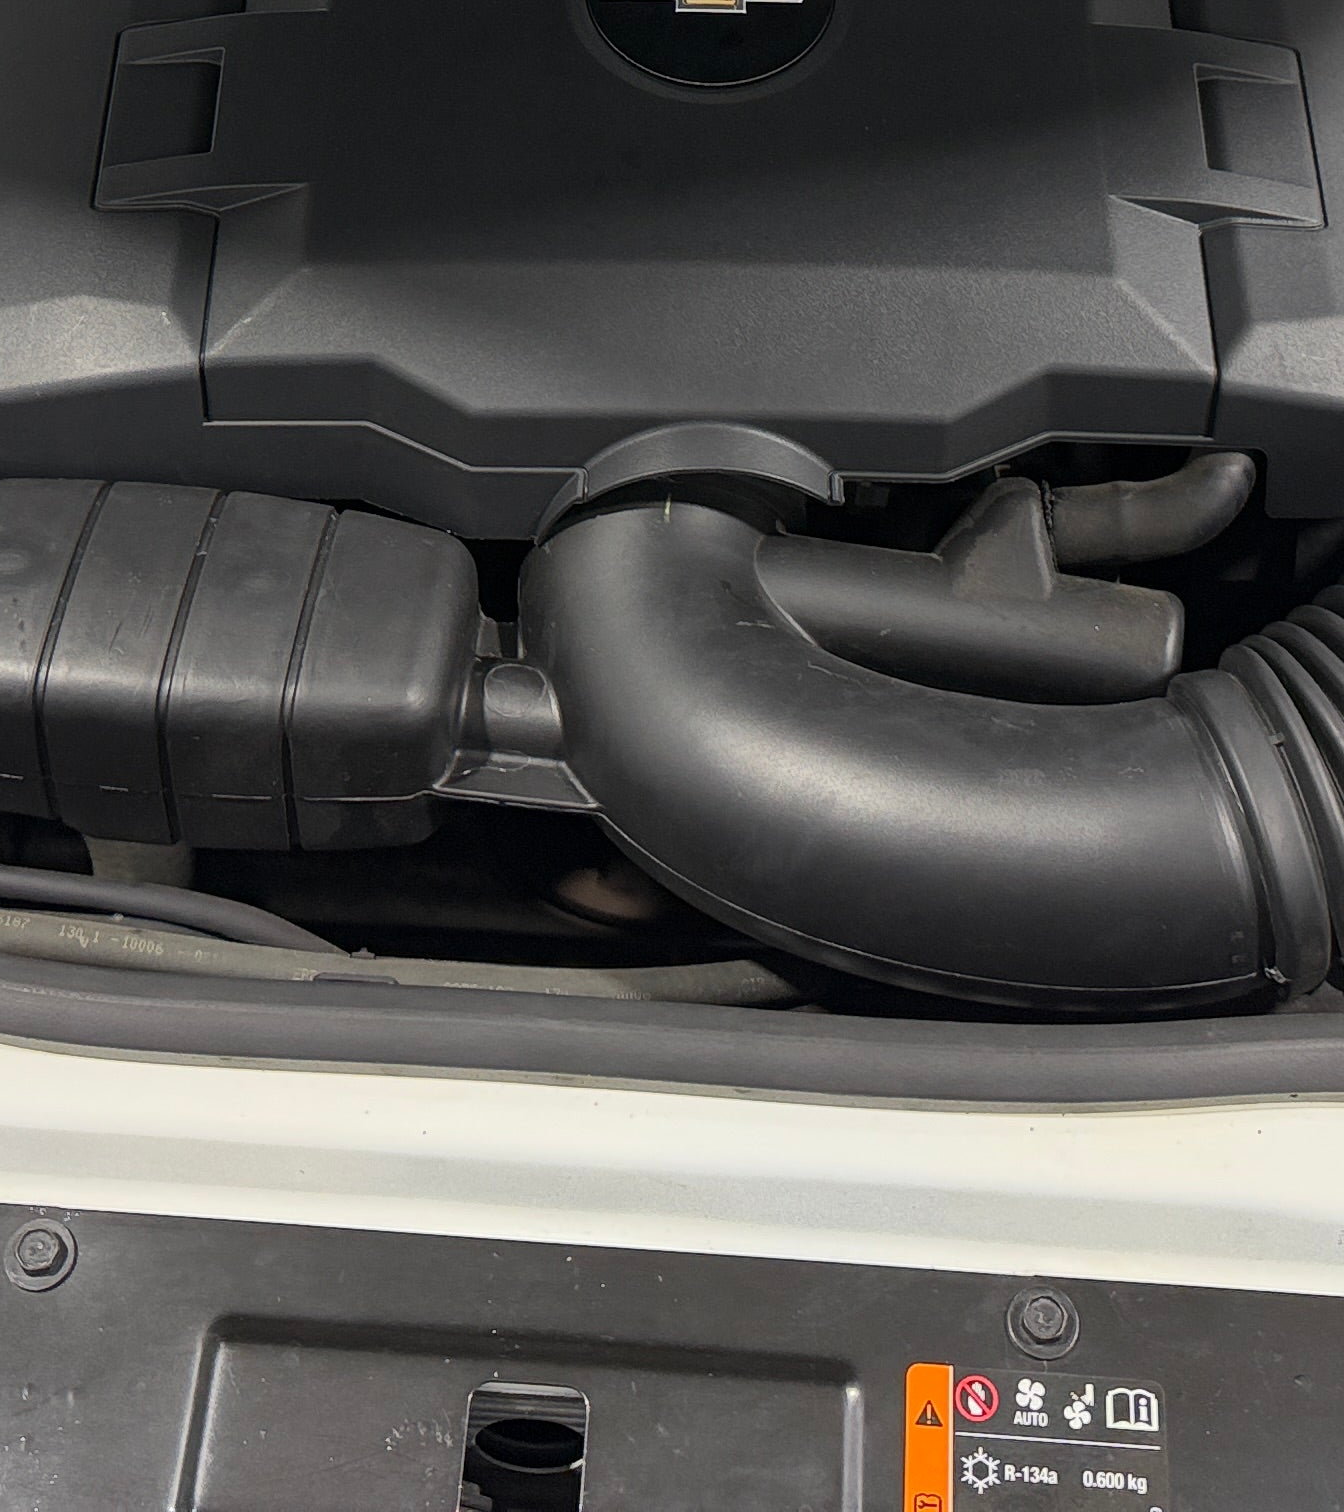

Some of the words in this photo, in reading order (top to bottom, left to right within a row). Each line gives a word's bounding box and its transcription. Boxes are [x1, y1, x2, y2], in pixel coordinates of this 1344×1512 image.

[1013, 1410, 1049, 1428] AUTO
[1004, 1463, 1059, 1485] R-134a
[1082, 1470, 1125, 1490] 0.600
[1127, 1473, 1148, 1495] kg
